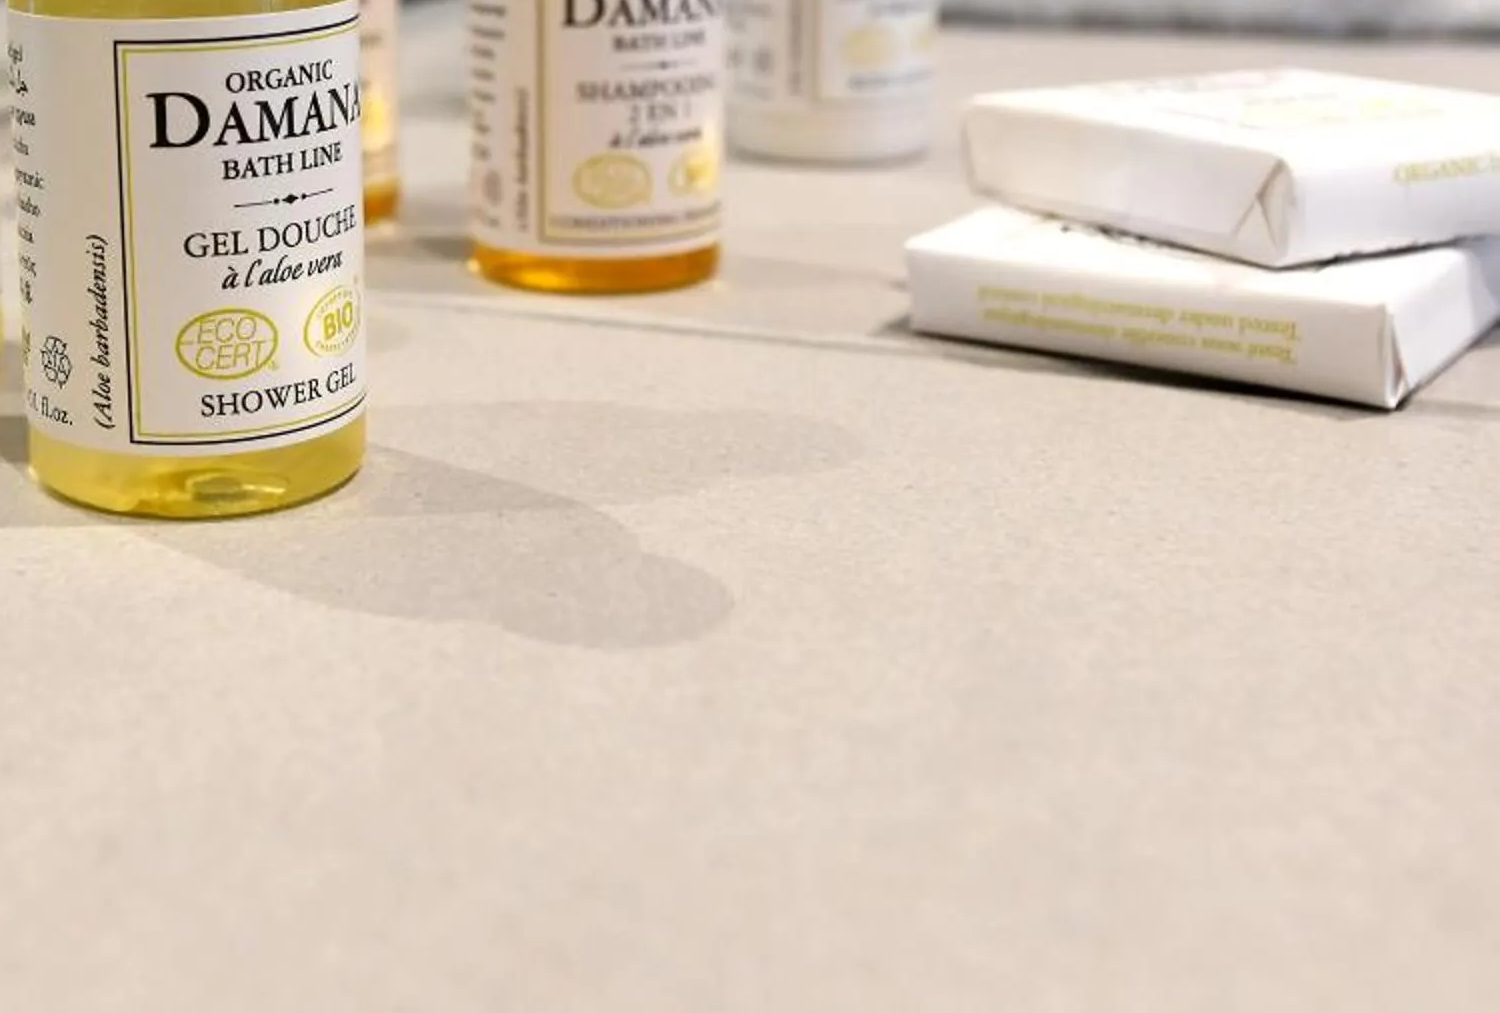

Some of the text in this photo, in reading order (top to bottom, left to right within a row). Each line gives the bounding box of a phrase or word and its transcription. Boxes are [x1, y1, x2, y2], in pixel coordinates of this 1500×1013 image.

[225, 59, 334, 93] ORGANIC
[145, 80, 361, 149] DAMANA
[221, 140, 344, 180] BATH LINE
[183, 204, 357, 259] GEL DOUCHE
[221, 265, 240, 290] à
[307, 250, 343, 277] vera
[86, 233, 116, 430] (Aloe barbadensis)
[197, 316, 258, 345] ECO
[322, 300, 354, 341] BIO
[195, 339, 267, 371] CERT
[200, 362, 357, 418] SHOWER GEL
